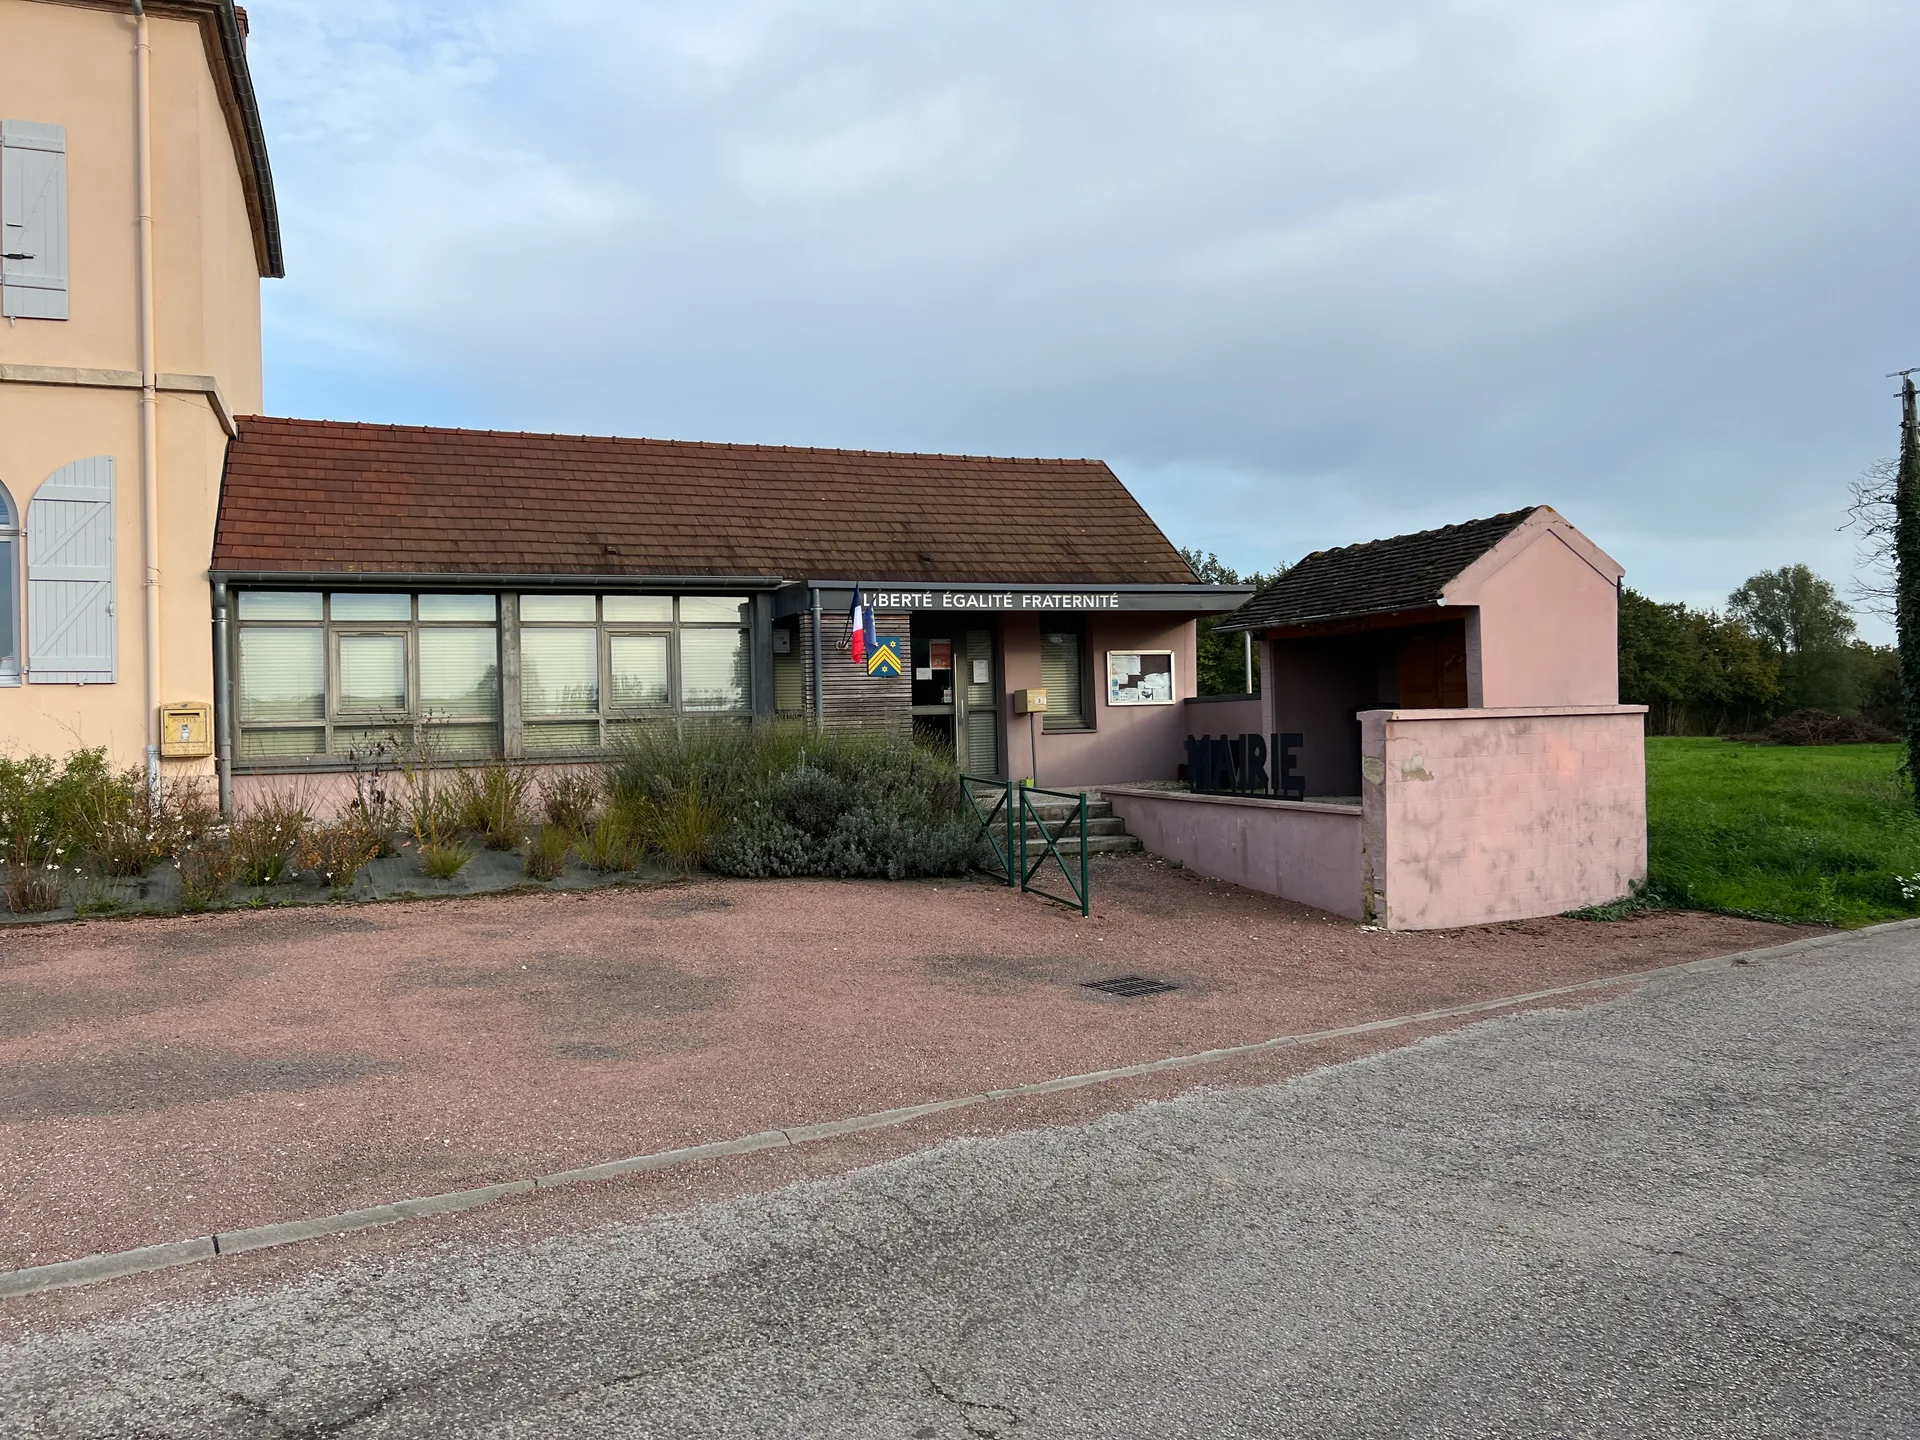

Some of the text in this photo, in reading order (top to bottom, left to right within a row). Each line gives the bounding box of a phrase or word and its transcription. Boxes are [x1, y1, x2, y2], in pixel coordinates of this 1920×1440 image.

[863, 591, 1119, 608] LIBERTÉ ÉGALITÉ FRATERNITÉ
[1187, 733, 1306, 792] MAIRIE
